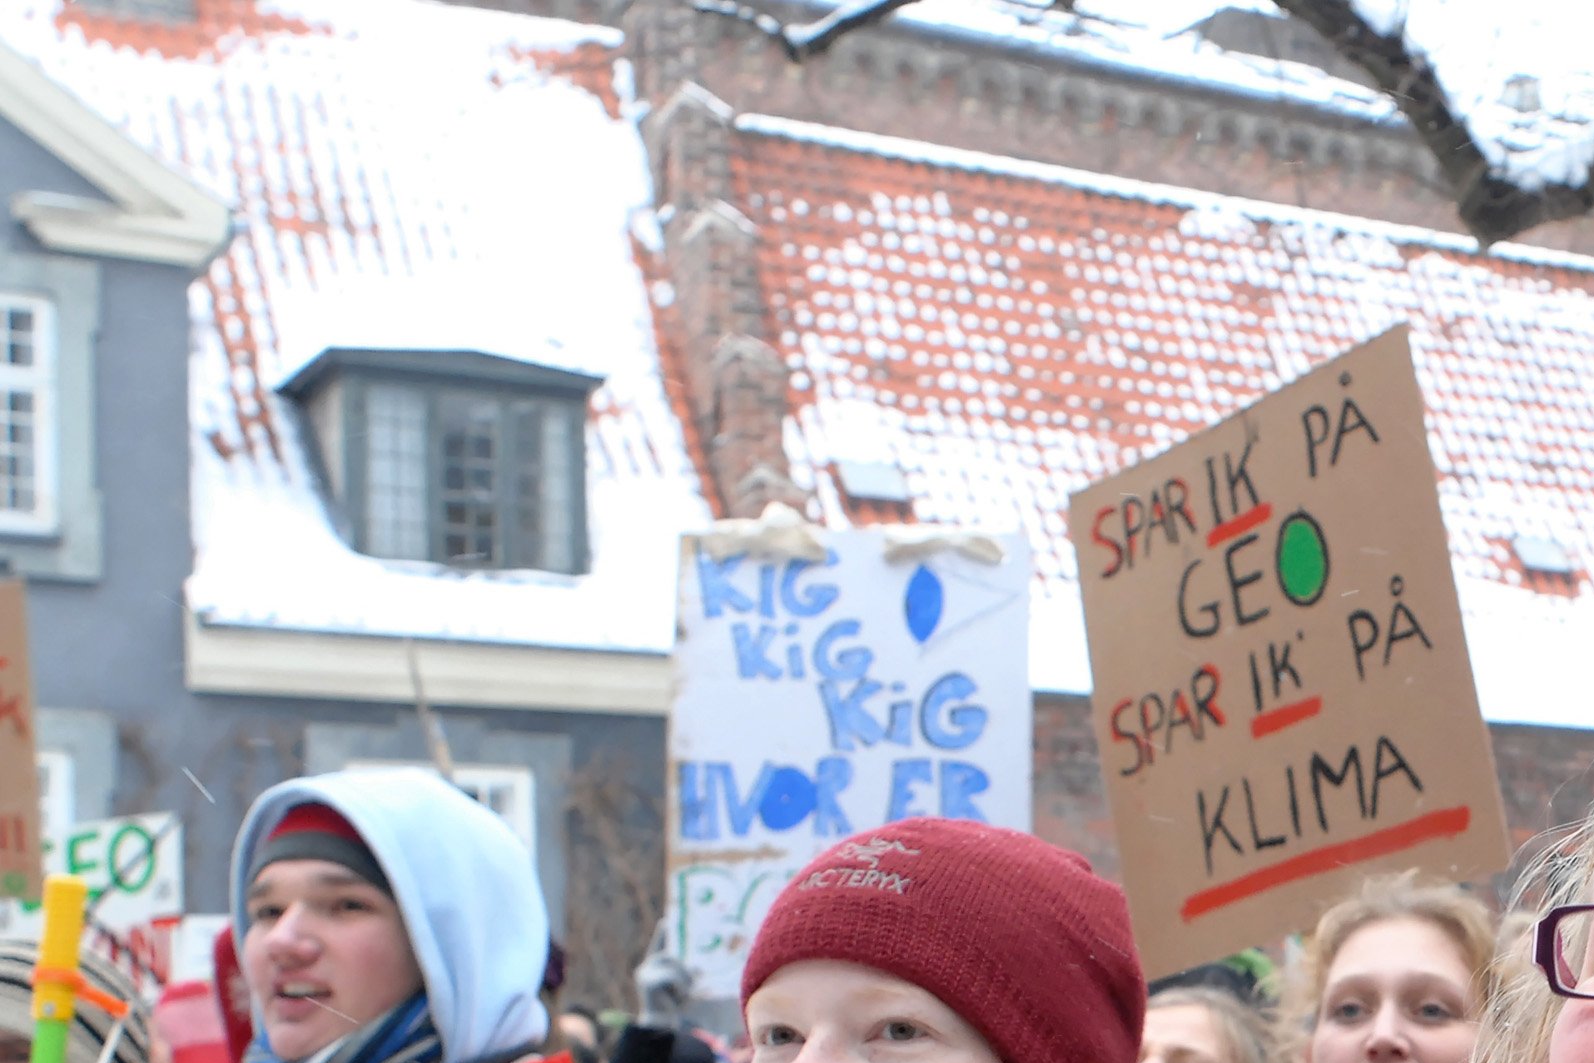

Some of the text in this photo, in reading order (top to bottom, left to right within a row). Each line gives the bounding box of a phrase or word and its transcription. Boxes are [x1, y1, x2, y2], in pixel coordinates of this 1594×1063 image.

[1091, 474, 1198, 580] SPAR
[1300, 370, 1381, 480] PÅ
[1176, 508, 1331, 640] GEO
[1110, 664, 1226, 776] SPAR
[1346, 574, 1434, 682] PÅ
[1195, 733, 1424, 878] KLIMA
